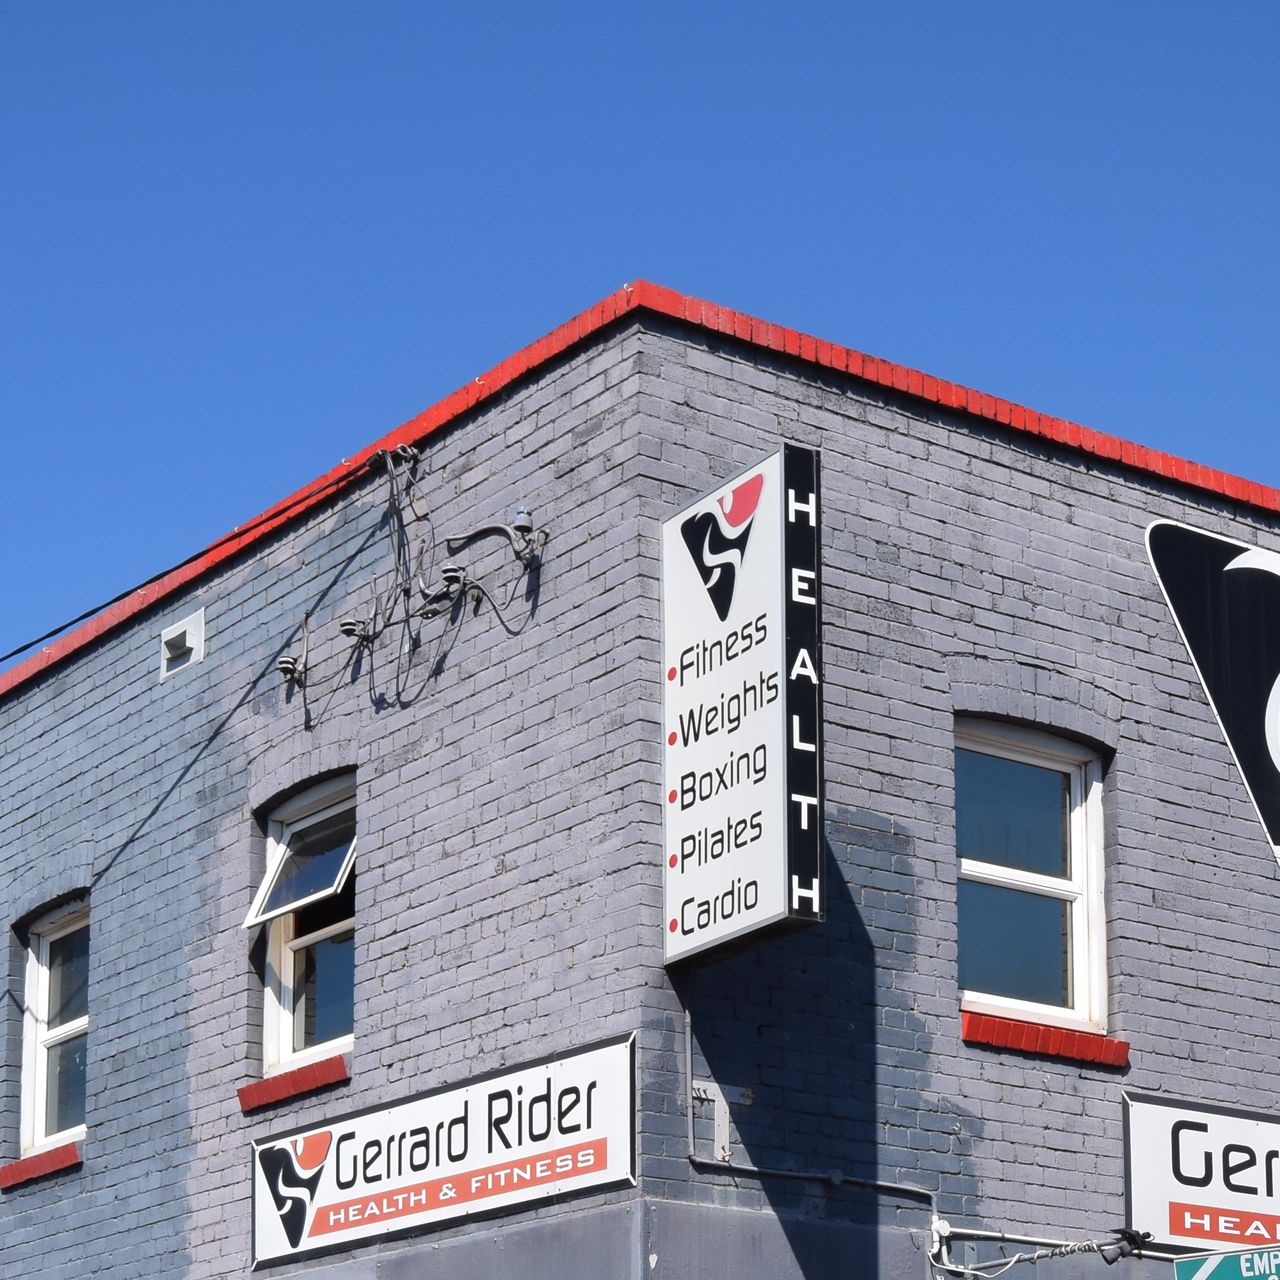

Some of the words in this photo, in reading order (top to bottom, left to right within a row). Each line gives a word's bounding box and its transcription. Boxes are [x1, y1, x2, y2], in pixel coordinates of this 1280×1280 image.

[679, 612, 768, 687] Fitness
[679, 671, 780, 748] Weights
[788, 488, 820, 912] HEALTH
[680, 742, 768, 811] Boxing
[680, 810, 764, 875] Pilates
[679, 877, 759, 937] Cardio
[335, 1099, 468, 1191] Gerrard
[487, 1076, 598, 1154] Rider
[328, 1186, 427, 1227] HEALTH
[438, 1183, 457, 1201] &
[470, 1148, 596, 1194] FITNESS
